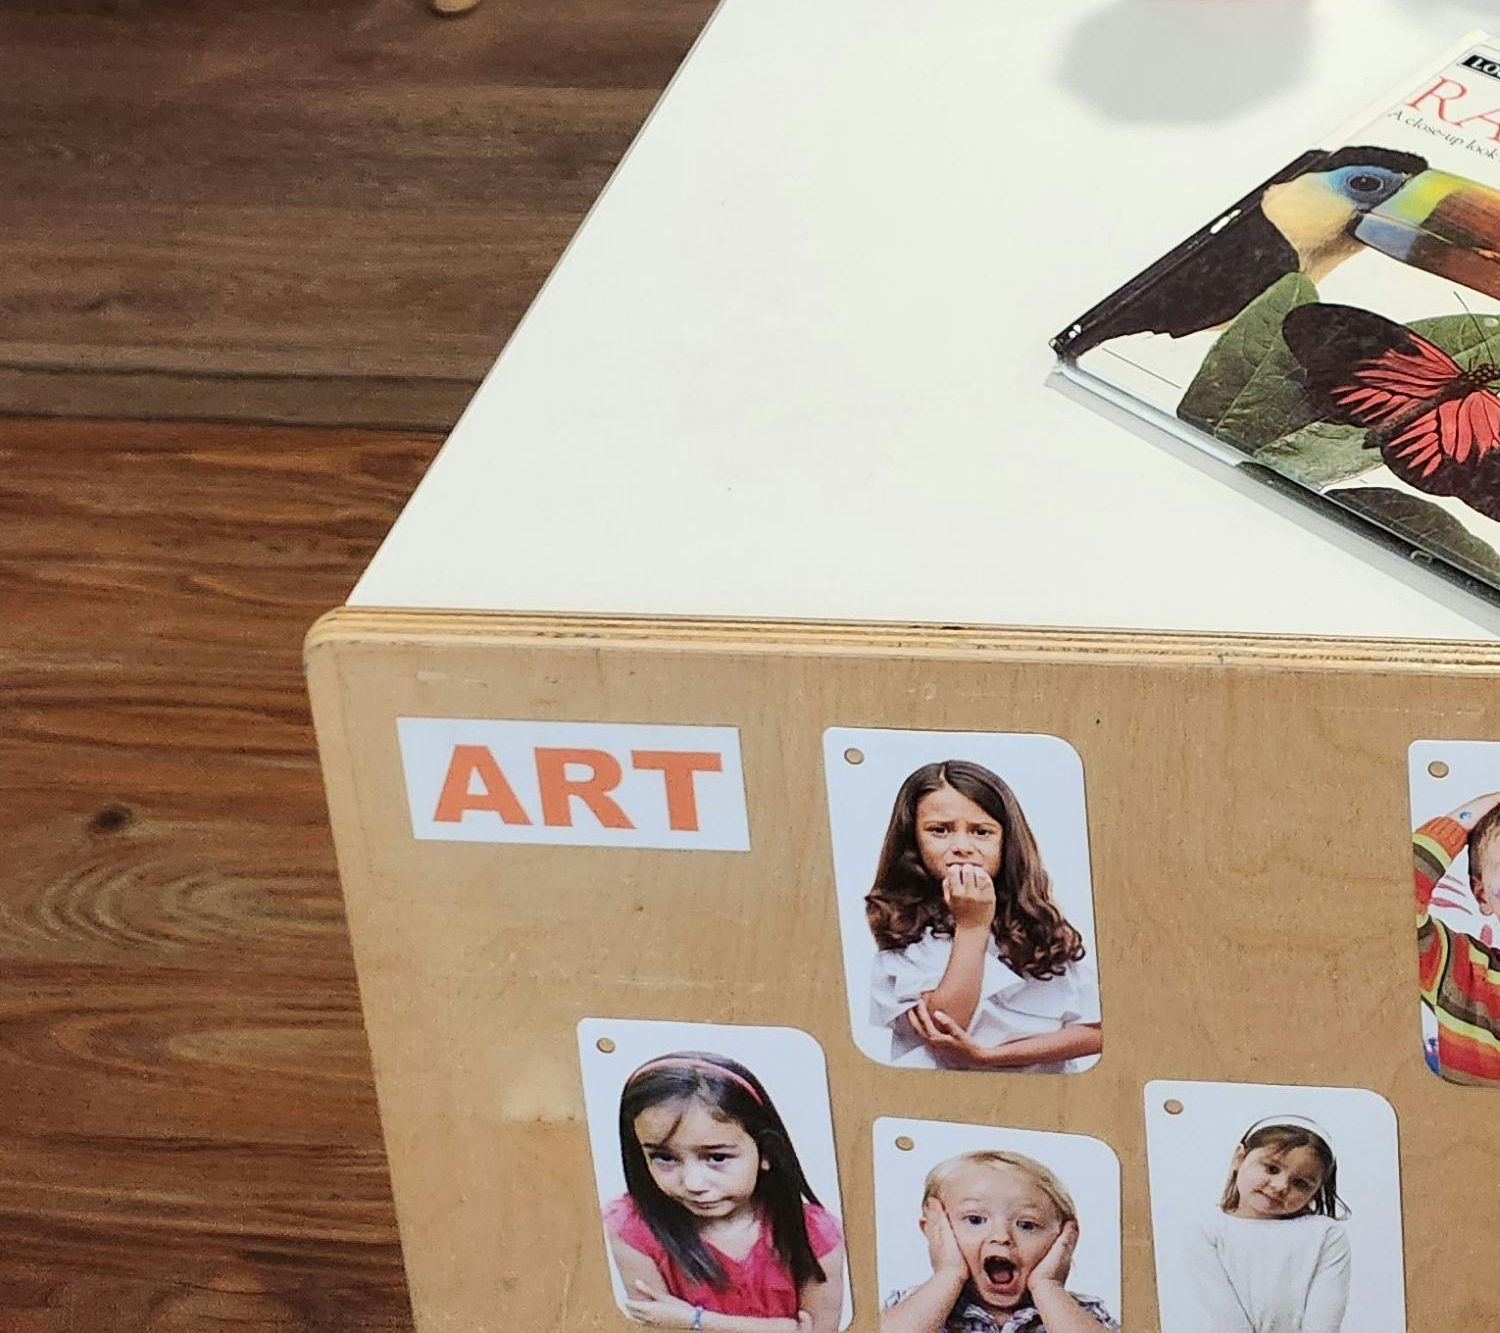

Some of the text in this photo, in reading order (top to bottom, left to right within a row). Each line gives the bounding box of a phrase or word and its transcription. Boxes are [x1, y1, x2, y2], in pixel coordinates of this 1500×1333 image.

[1387, 108, 1402, 121] A
[1404, 113, 1465, 146] close-up
[1465, 138, 1497, 161] look
[432, 744, 723, 832] ART
